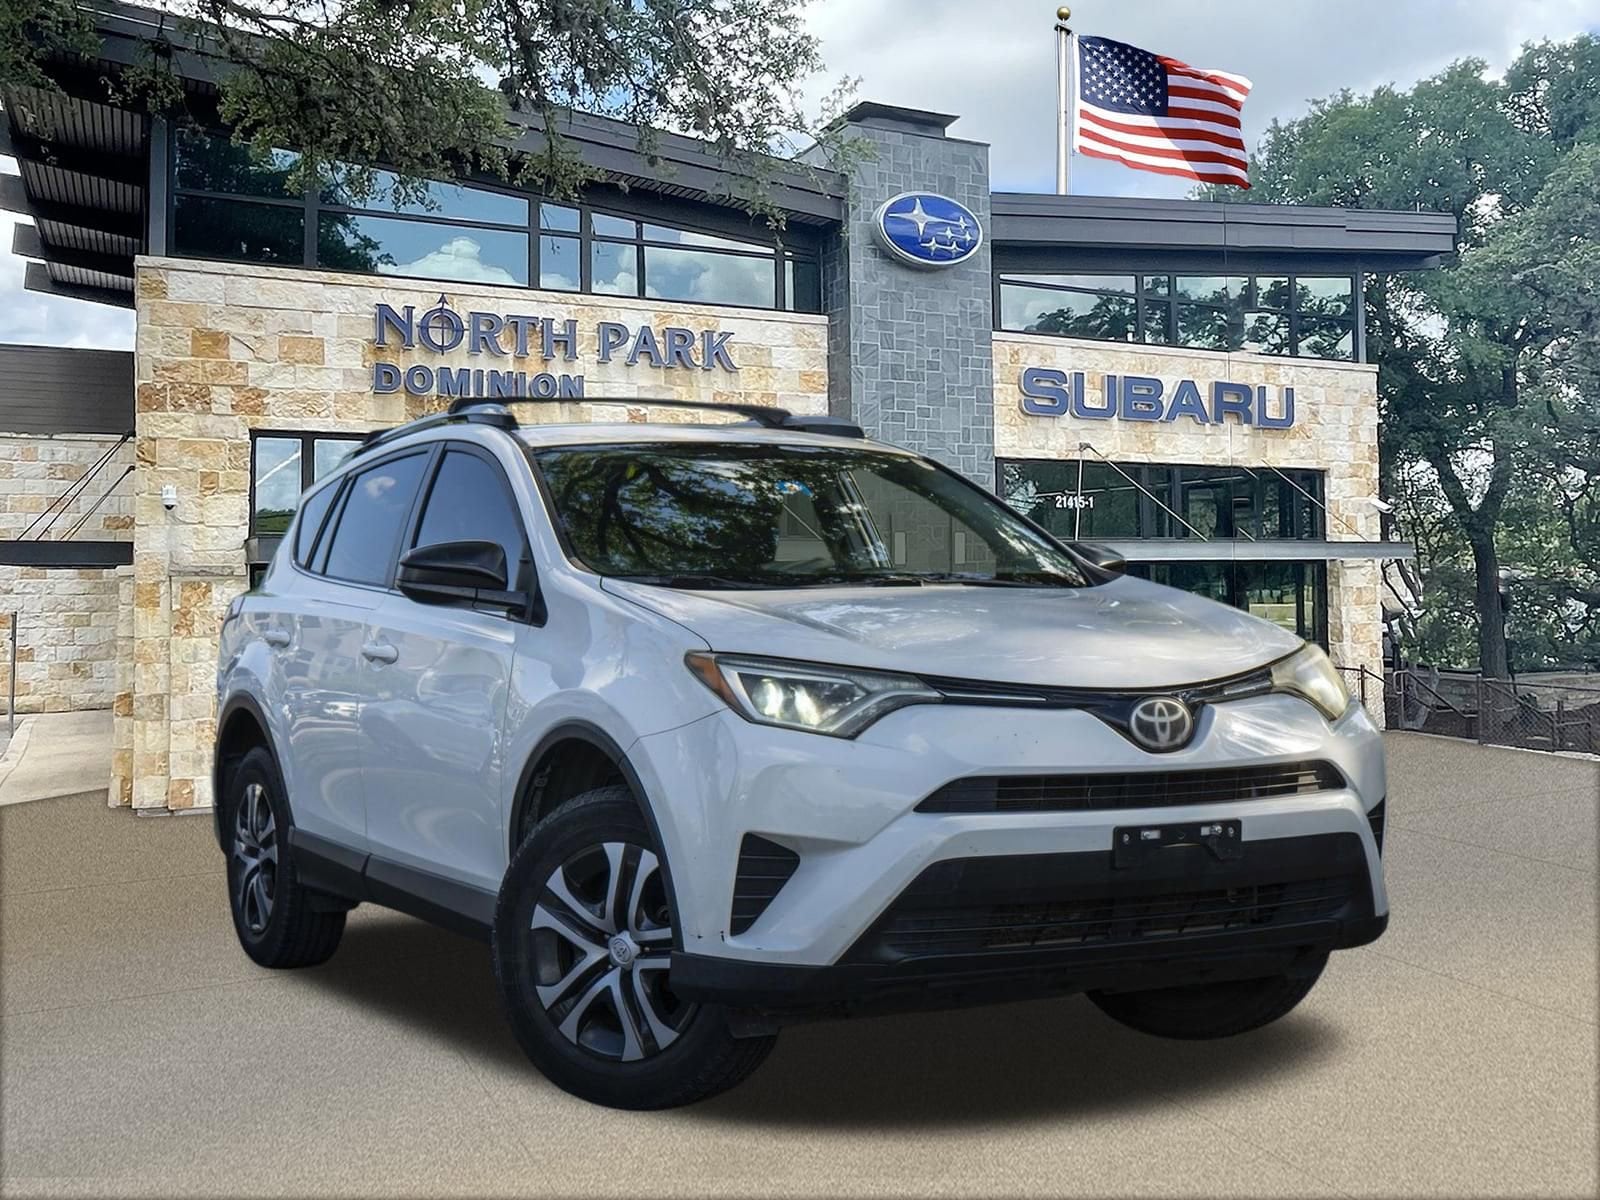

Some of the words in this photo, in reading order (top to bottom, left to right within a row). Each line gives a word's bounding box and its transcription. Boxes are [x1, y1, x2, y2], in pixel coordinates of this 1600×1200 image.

[374, 298, 579, 361] NORTH
[597, 321, 741, 372] PARK
[373, 362, 585, 400] DOMINION
[1019, 367, 1295, 429] SUBARU
